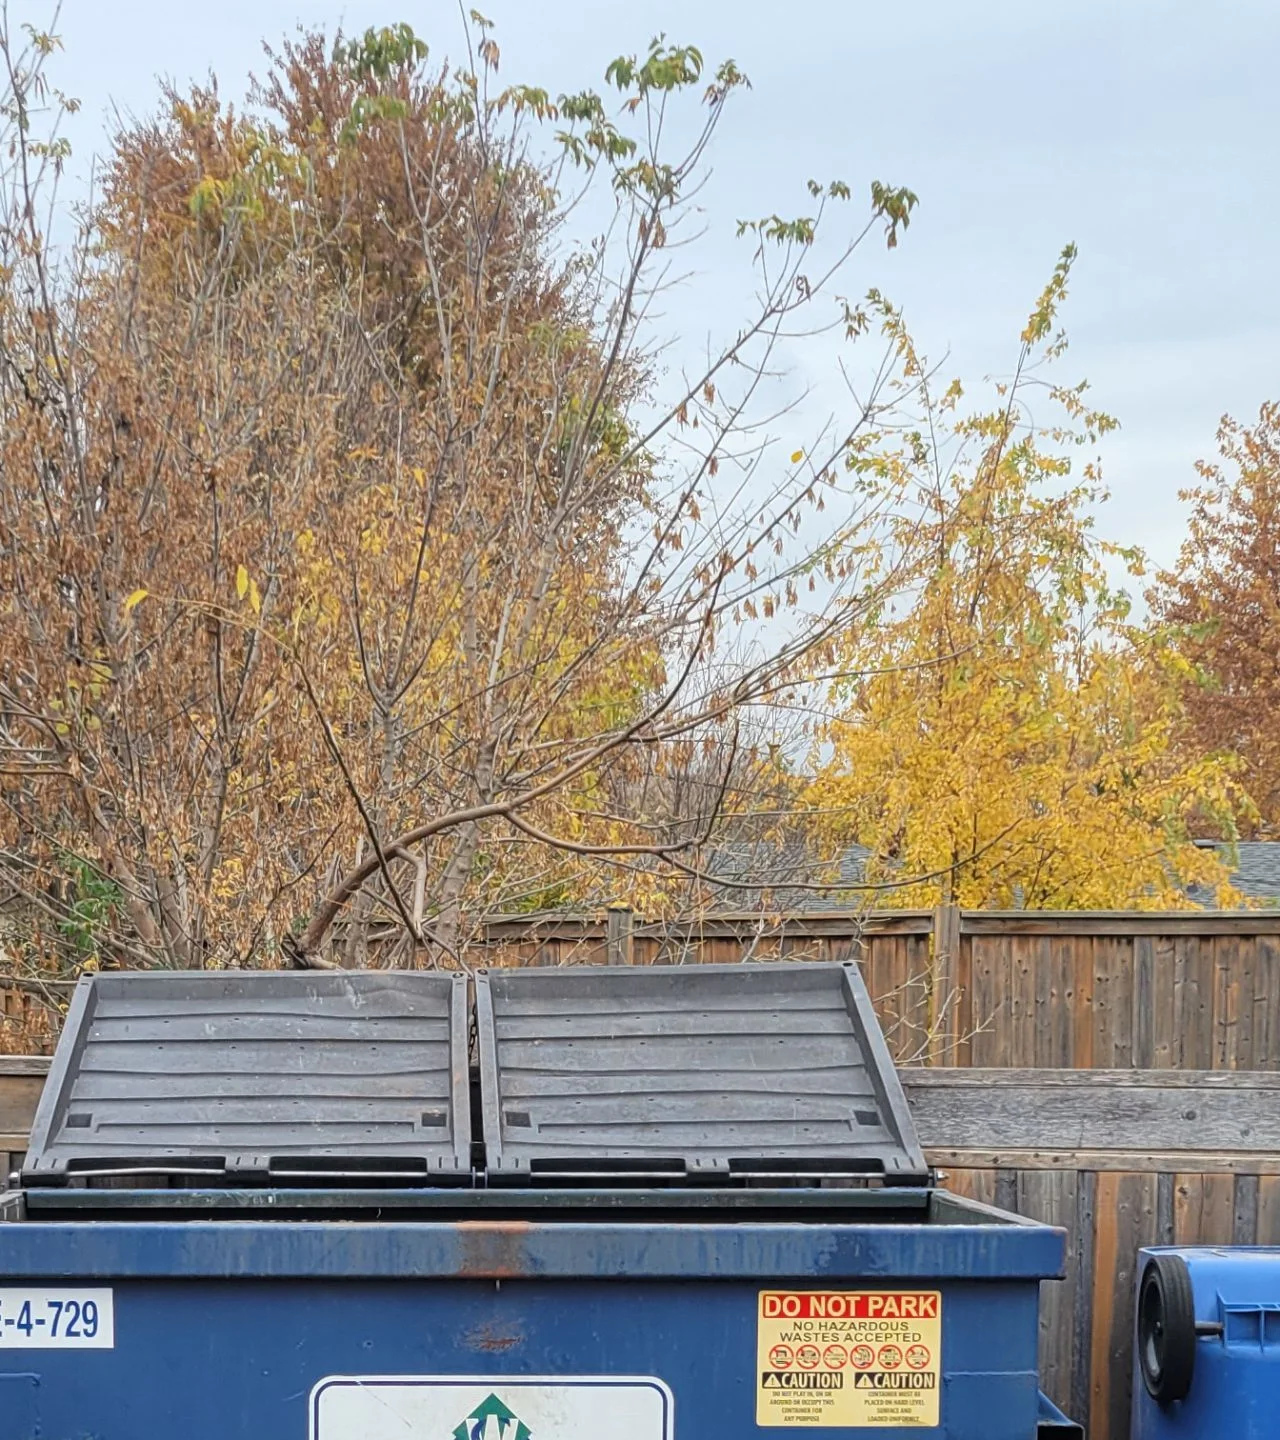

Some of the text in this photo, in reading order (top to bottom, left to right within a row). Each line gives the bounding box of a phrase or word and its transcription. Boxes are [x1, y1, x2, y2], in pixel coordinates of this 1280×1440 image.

[764, 1296, 936, 1317] DO NOT PARK
[793, 1322, 909, 1331] NO HAZARDOUS
[780, 1332, 922, 1343] WASTES ACCEPTED
[781, 1373, 842, 1389] CAUTION
[873, 1373, 934, 1389] CAUTION
